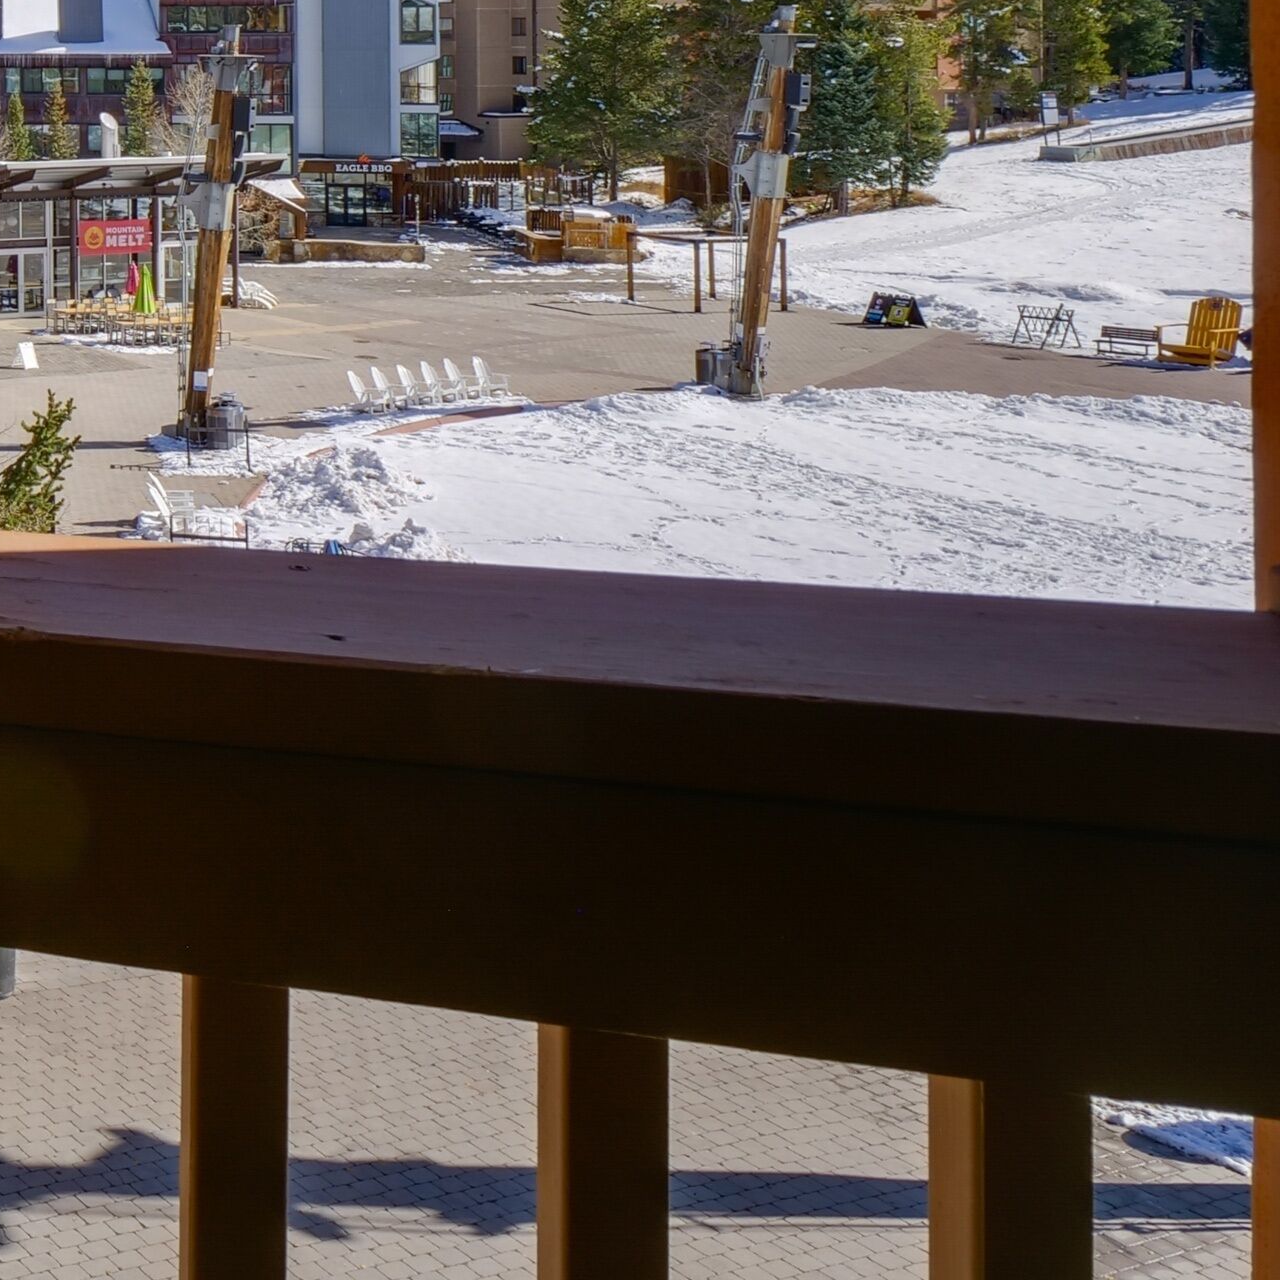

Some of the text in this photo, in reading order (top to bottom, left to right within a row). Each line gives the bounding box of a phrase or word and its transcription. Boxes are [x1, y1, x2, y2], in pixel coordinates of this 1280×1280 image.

[335, 164, 393, 172] EAGLE BBQ
[105, 234, 145, 247] MELT
